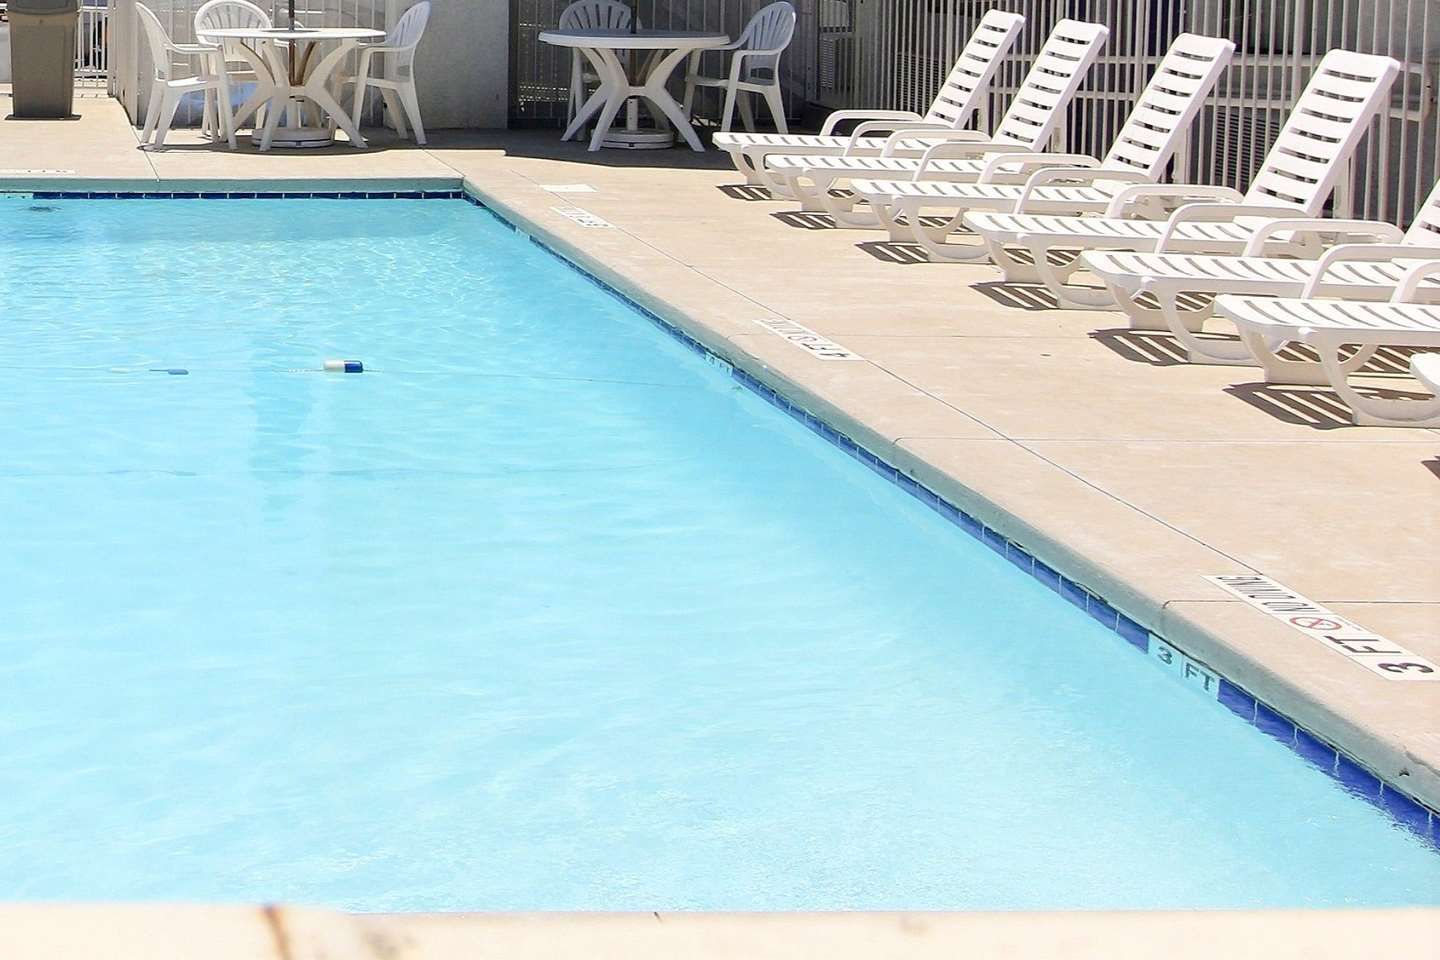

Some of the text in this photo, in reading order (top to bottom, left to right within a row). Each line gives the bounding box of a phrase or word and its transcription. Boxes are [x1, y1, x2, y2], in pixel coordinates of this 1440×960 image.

[1324, 635, 1403, 654] FT
[1157, 646, 1216, 691] 3 FT
[1377, 661, 1434, 674] 3
